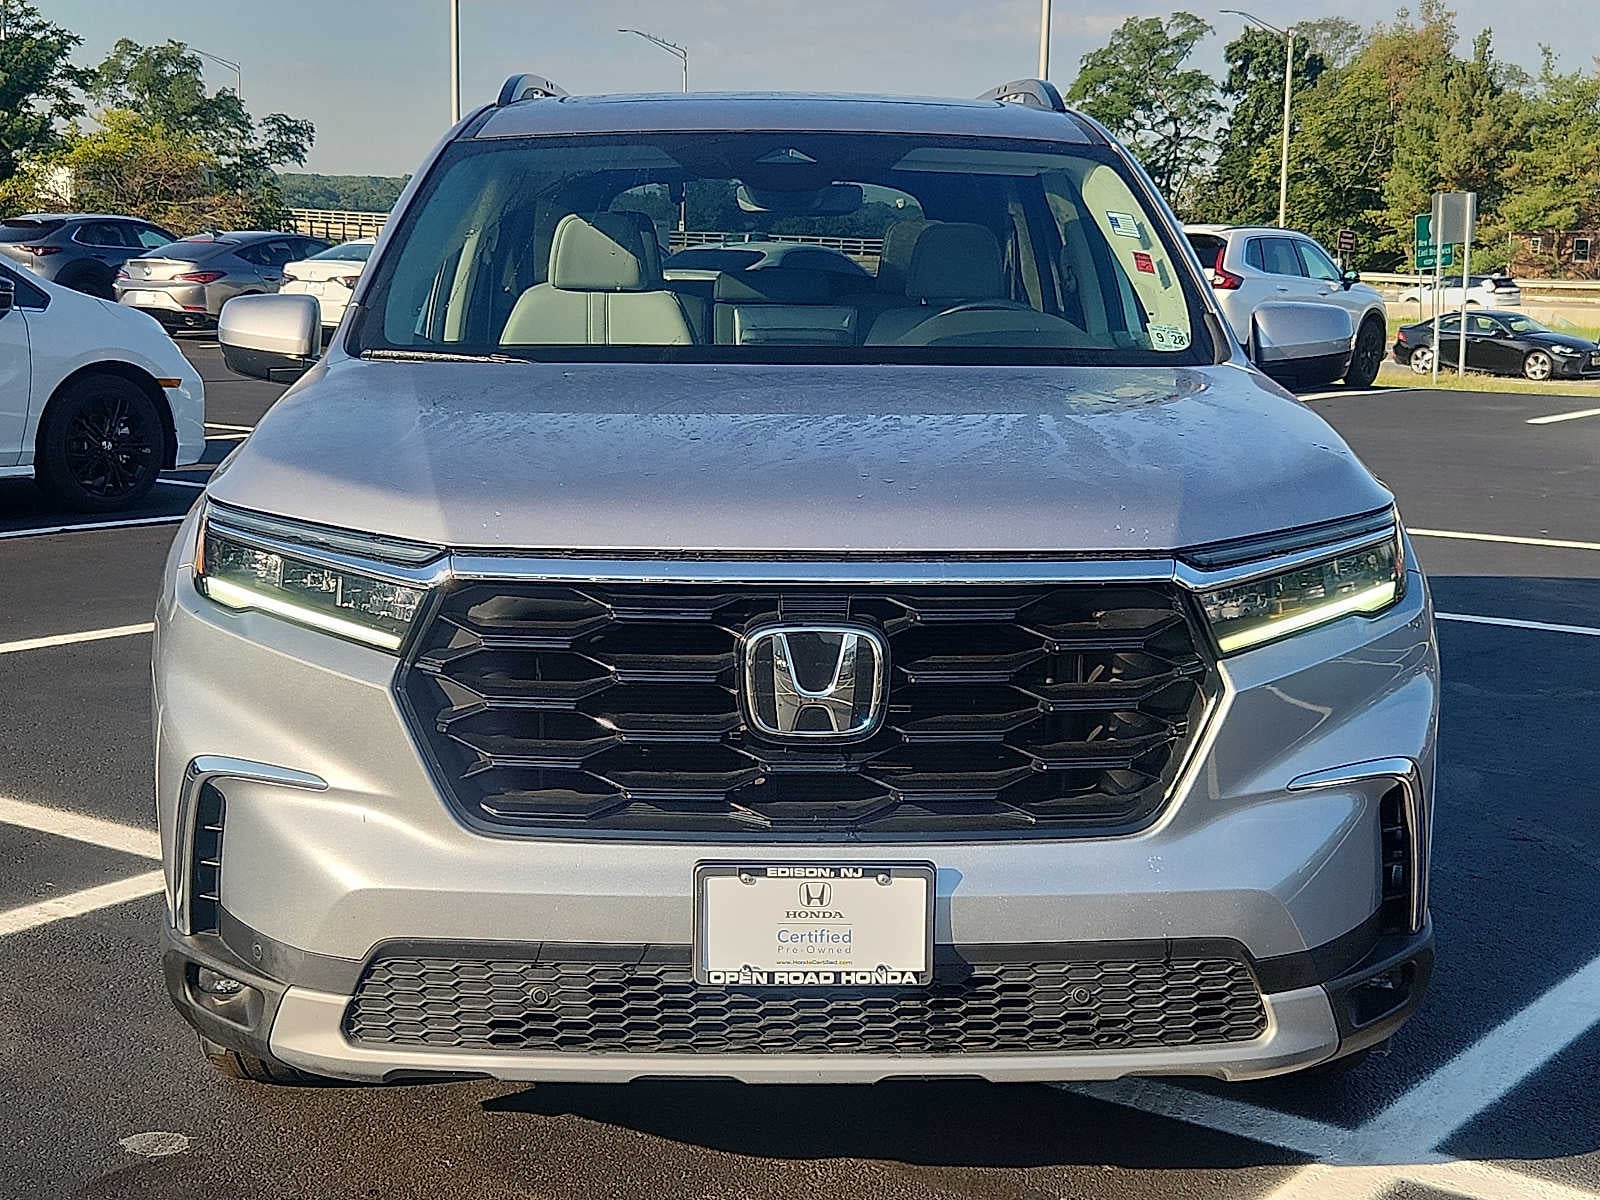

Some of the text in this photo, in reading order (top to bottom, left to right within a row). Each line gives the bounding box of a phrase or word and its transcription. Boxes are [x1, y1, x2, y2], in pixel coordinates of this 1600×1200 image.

[1156, 332, 1164, 343] 9
[840, 867, 863, 878] NJ
[785, 910, 845, 919] HONDA
[777, 929, 852, 944] Certified
[777, 945, 852, 954] Pre-Owned
[709, 970, 918, 985] OPEN ROAD HONDA
